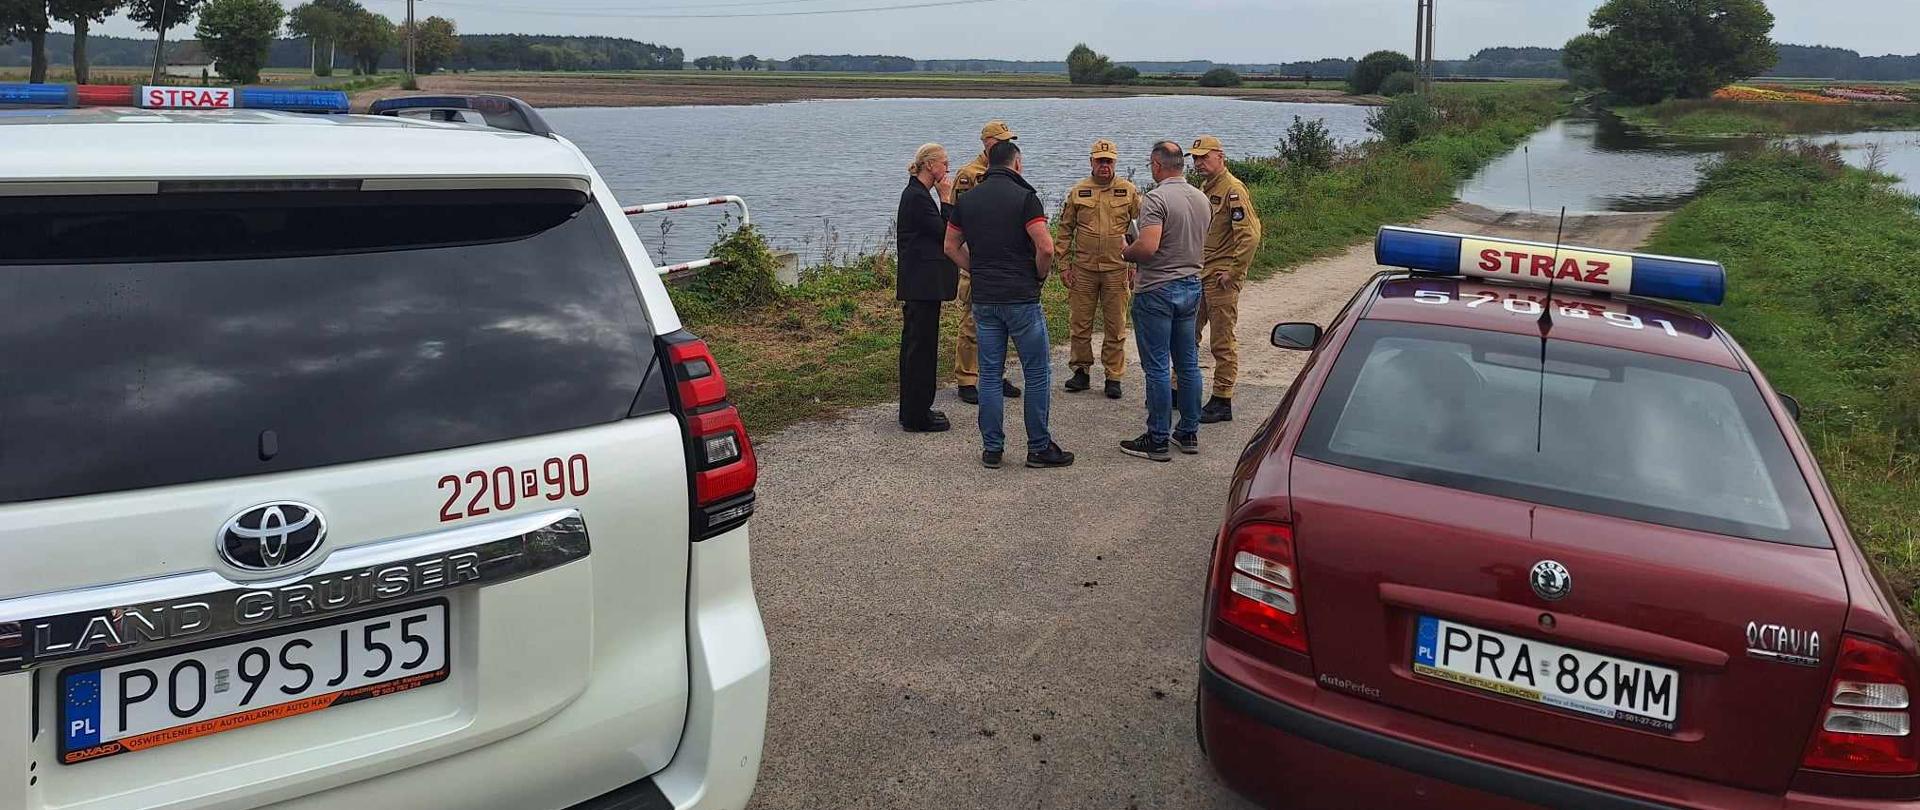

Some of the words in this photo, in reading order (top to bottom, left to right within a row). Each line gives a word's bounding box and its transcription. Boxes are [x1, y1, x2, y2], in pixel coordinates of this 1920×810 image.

[1413, 289, 1543, 315] 570
[1602, 311, 1679, 337] 91
[437, 466, 516, 522] 220
[543, 453, 590, 501] 90
[34, 601, 211, 659] LAND
[234, 551, 481, 627] CRUISER
[1417, 645, 1433, 660] PL
[1746, 621, 1820, 658] OCTAVIA
[118, 659, 207, 732] PO
[237, 614, 430, 706] 9SJ55
[1320, 673, 1381, 697] AutoPerfect
[1442, 626, 1536, 687] PRA
[1555, 653, 1673, 716] 86WM
[70, 718, 96, 738] PL
[286, 701, 309, 713] AUTO
